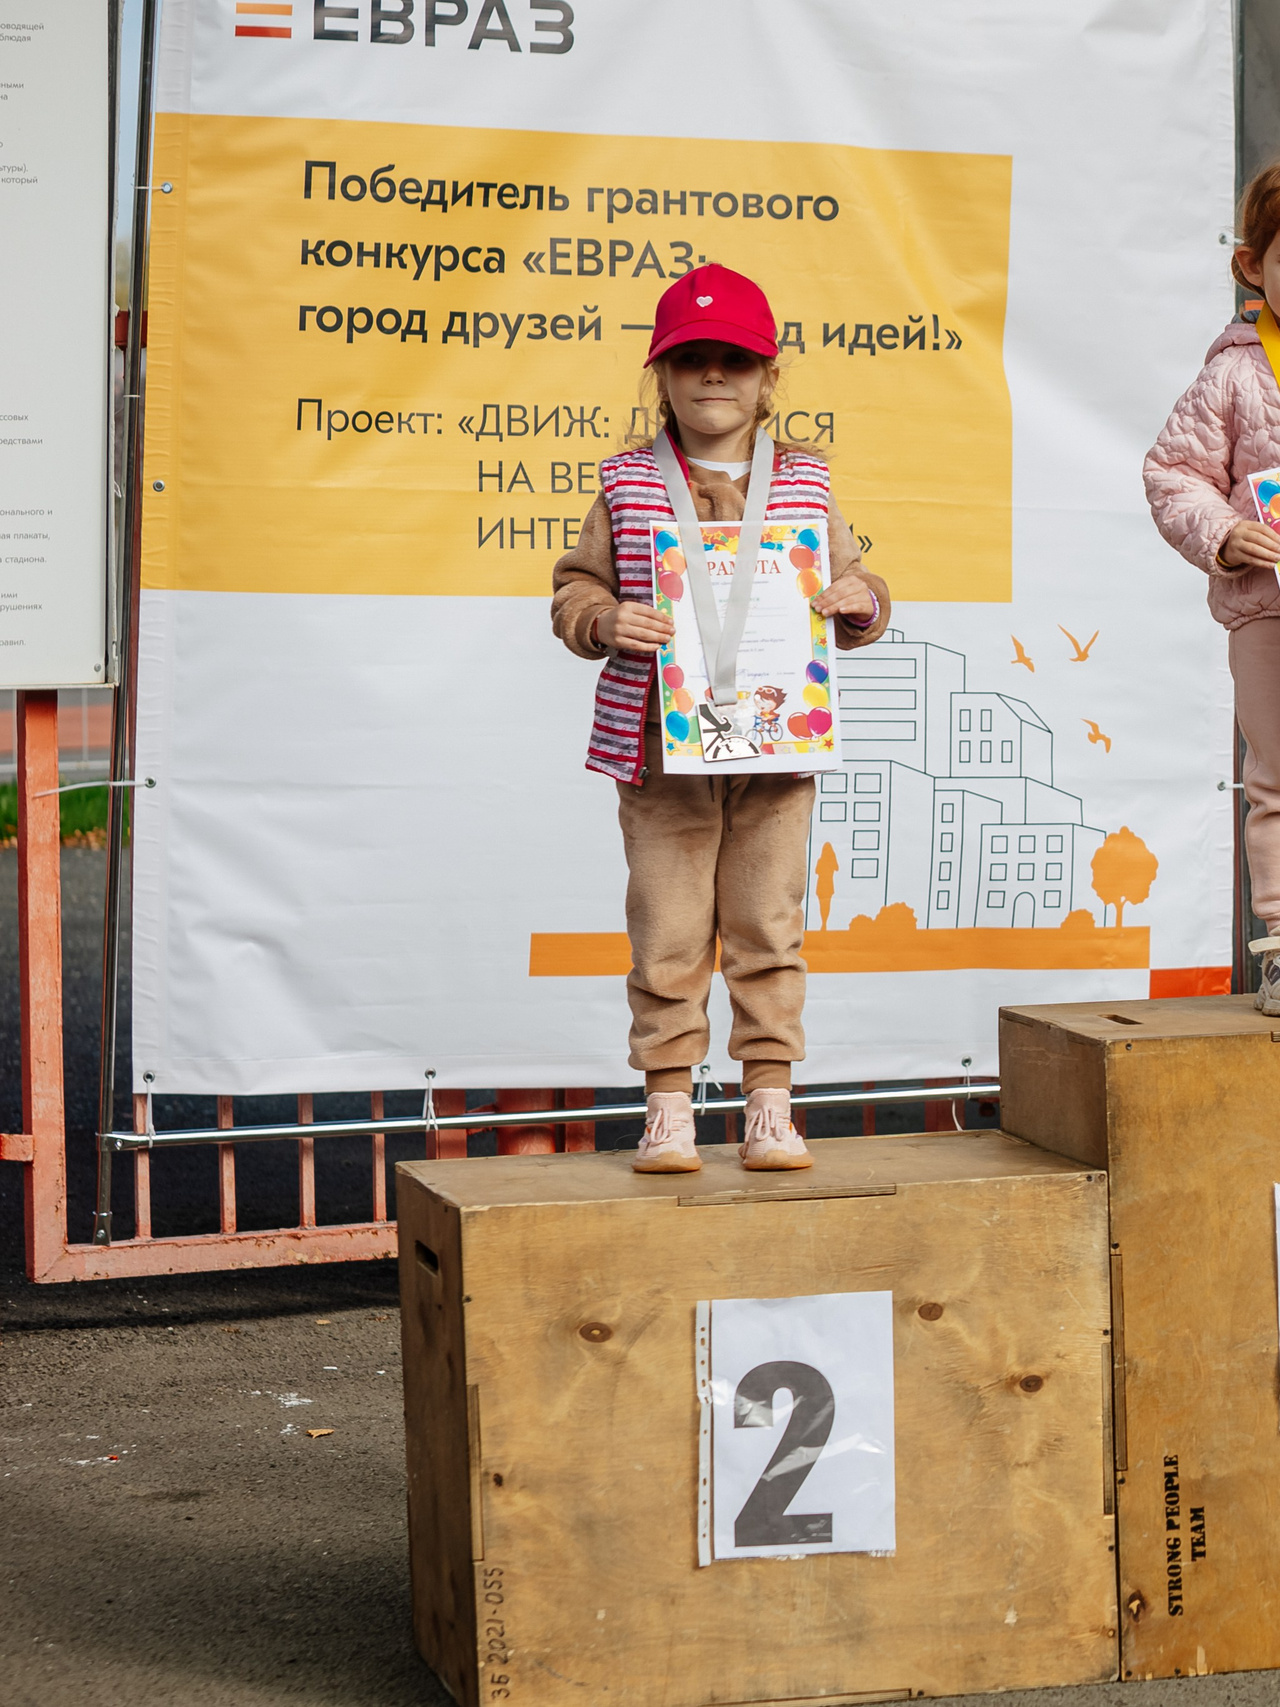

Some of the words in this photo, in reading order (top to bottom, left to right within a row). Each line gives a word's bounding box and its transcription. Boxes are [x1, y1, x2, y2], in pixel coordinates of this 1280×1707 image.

[313, 0, 575, 54] ЕВРАЗ
[304, 160, 570, 213] Победитель
[587, 187, 839, 223] грантового
[300, 239, 506, 281] конкурса
[298, 305, 428, 343] город
[441, 305, 602, 349] друзей
[823, 314, 962, 356] идей!»
[296, 398, 443, 440] Проект:
[458, 403, 610, 442] «ДВИЖ:
[478, 460, 535, 493] НА
[5, 556, 47, 564] стадиона.
[734, 1360, 836, 1547] 2
[1164, 1454, 1181, 1532] PEOPLE
[1190, 1506, 1207, 1562] TEAM
[1166, 1537, 1184, 1617] STRONG
